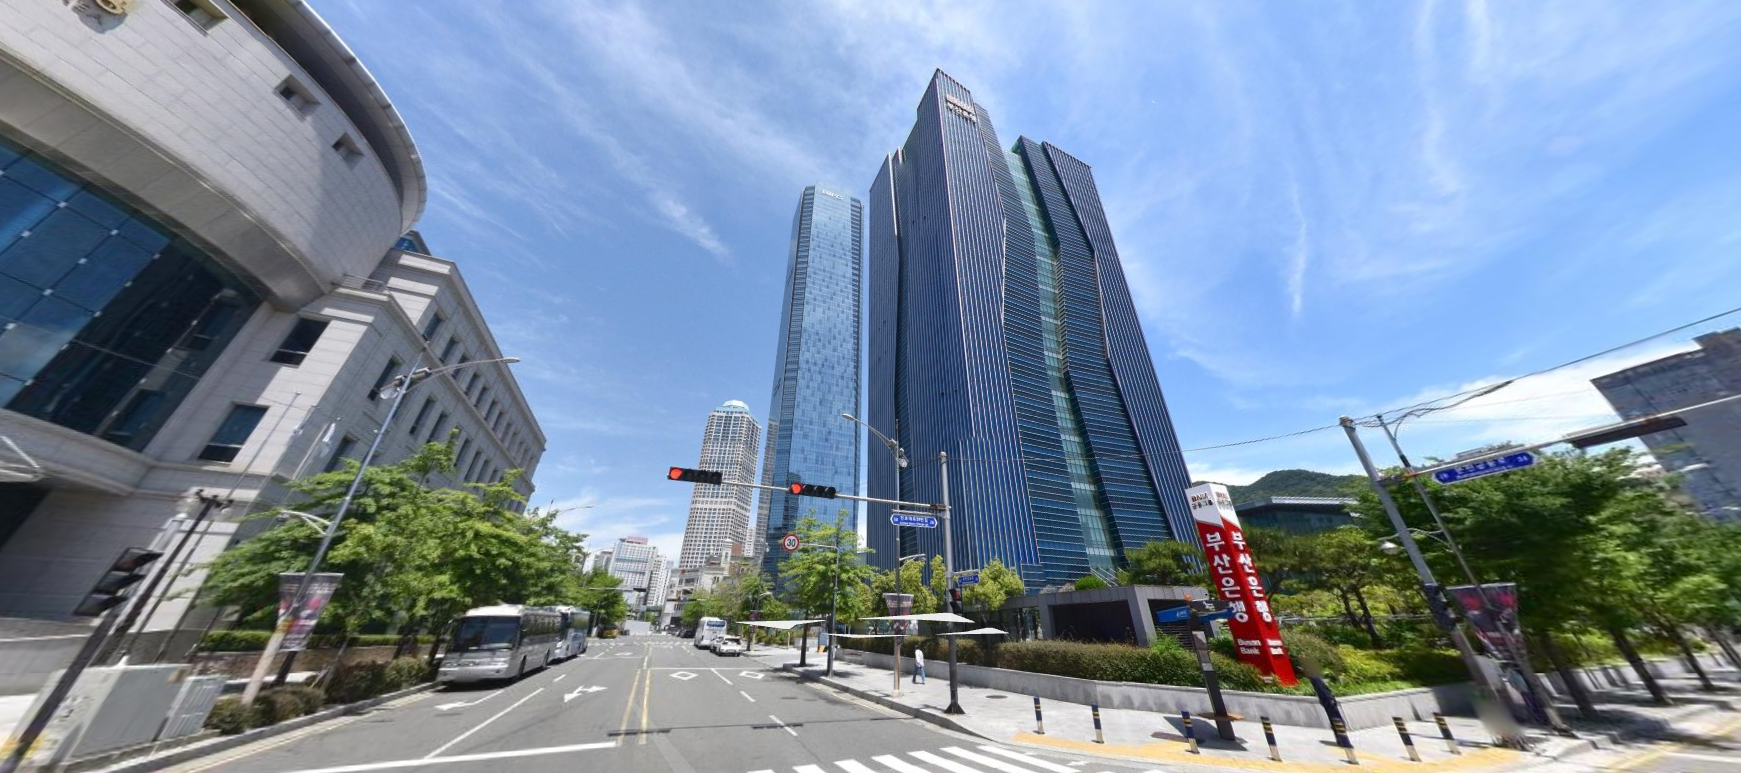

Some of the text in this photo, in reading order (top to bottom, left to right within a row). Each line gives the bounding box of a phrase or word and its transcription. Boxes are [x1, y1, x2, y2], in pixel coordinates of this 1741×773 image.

[786, 538, 796, 547] 30
[1206, 532, 1249, 623] 부산은행
[1231, 530, 1272, 623] 부산은행
[1240, 647, 1260, 655] Bank
